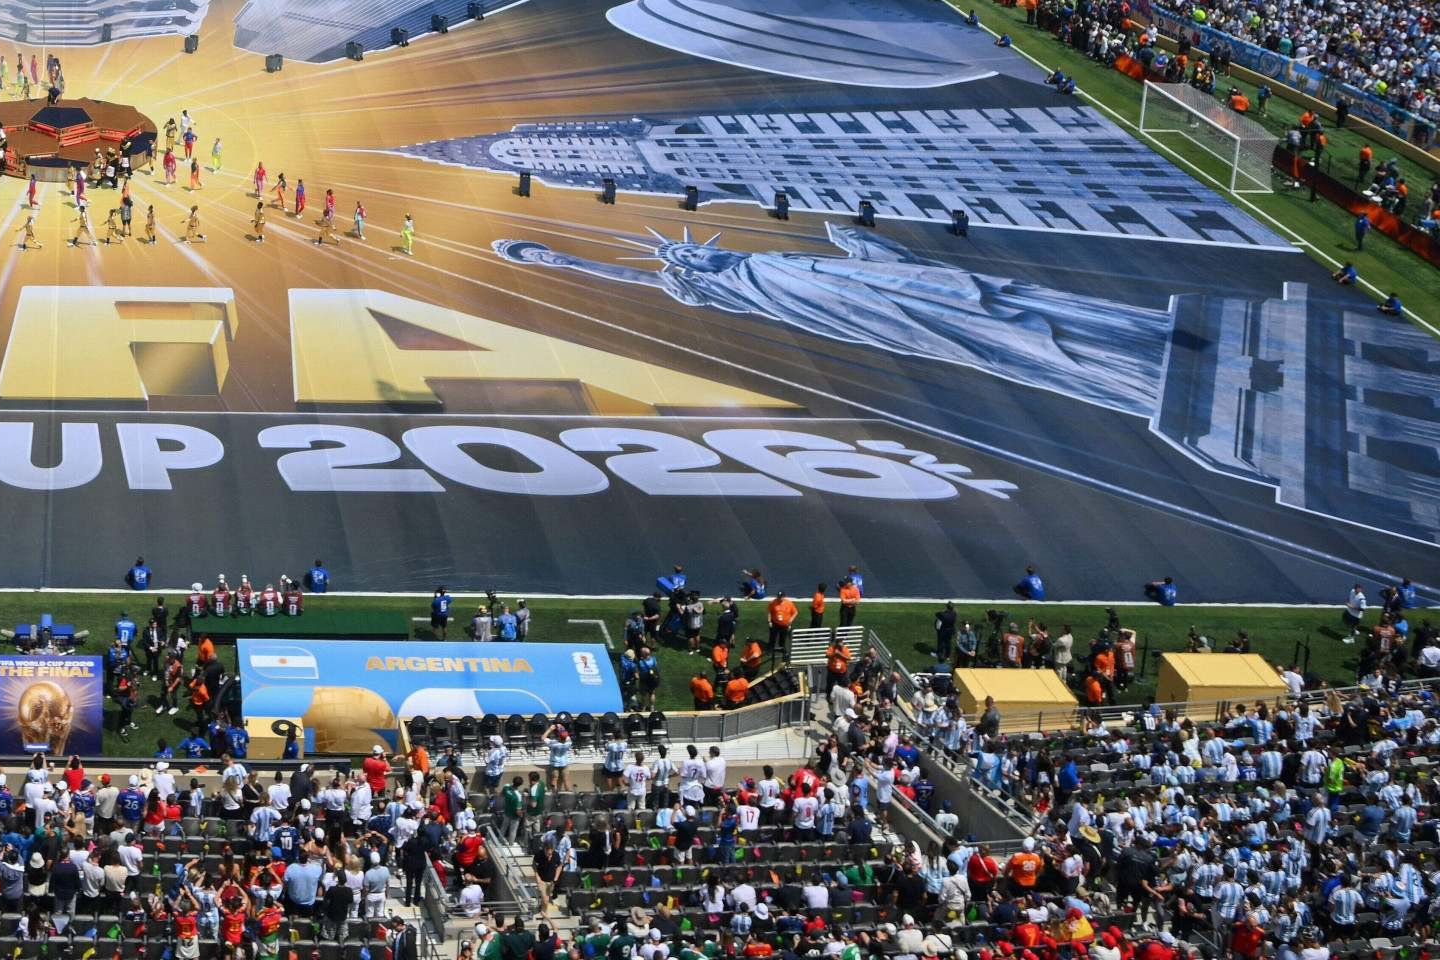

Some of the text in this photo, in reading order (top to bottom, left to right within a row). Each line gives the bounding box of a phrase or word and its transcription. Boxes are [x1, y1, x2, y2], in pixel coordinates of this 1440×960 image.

[258, 424, 959, 500] 2026
[365, 655, 534, 673] ARGENTINA
[37, 666, 95, 678] FINAL
[124, 799, 138, 810] 26
[746, 810, 755, 823] 17
[280, 836, 293, 851] 10
